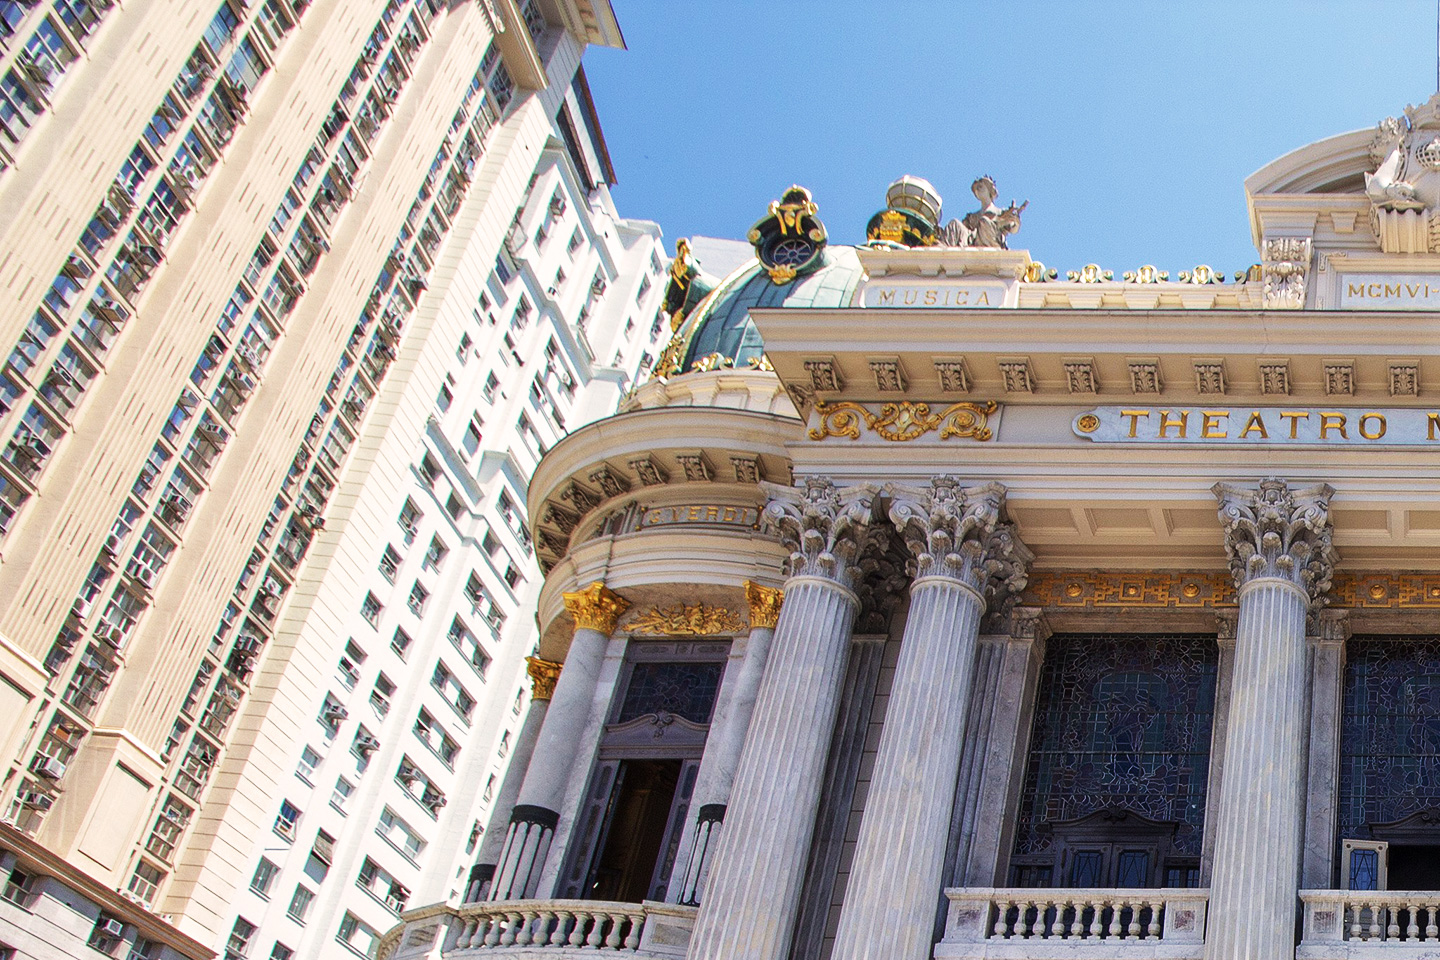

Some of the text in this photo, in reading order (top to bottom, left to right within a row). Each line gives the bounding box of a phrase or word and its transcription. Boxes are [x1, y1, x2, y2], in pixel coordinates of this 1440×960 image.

[878, 289, 990, 306] MUSICA
[1119, 409, 1387, 440] THEATRO
[672, 505, 749, 524] VERDI
